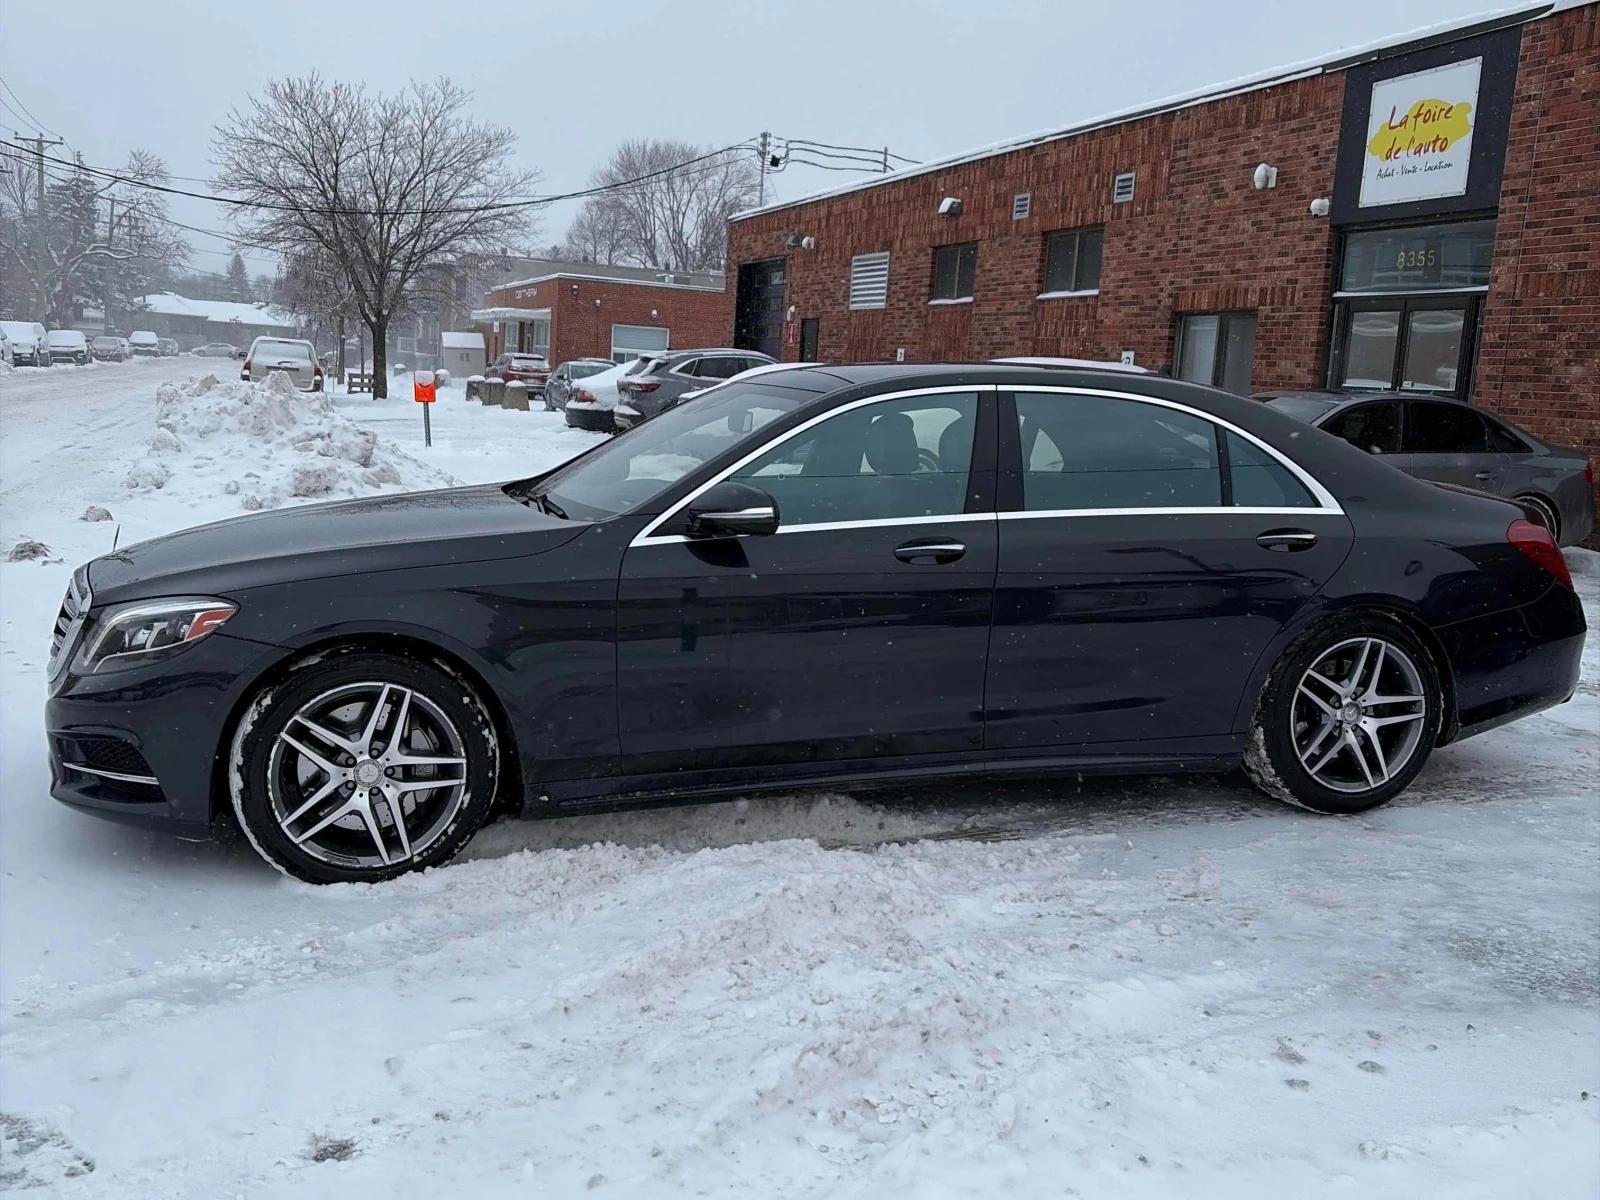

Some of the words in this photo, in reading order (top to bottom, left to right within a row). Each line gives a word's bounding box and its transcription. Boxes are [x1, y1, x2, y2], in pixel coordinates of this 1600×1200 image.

[1388, 105, 1409, 130] La
[1413, 103, 1454, 132] foire
[1385, 136, 1402, 162] de
[1407, 133, 1448, 158] l'auto
[1376, 167, 1395, 180] Achat
[1401, 164, 1418, 176] Vente
[1424, 160, 1453, 172] Location
[1396, 249, 1436, 269] 8355
